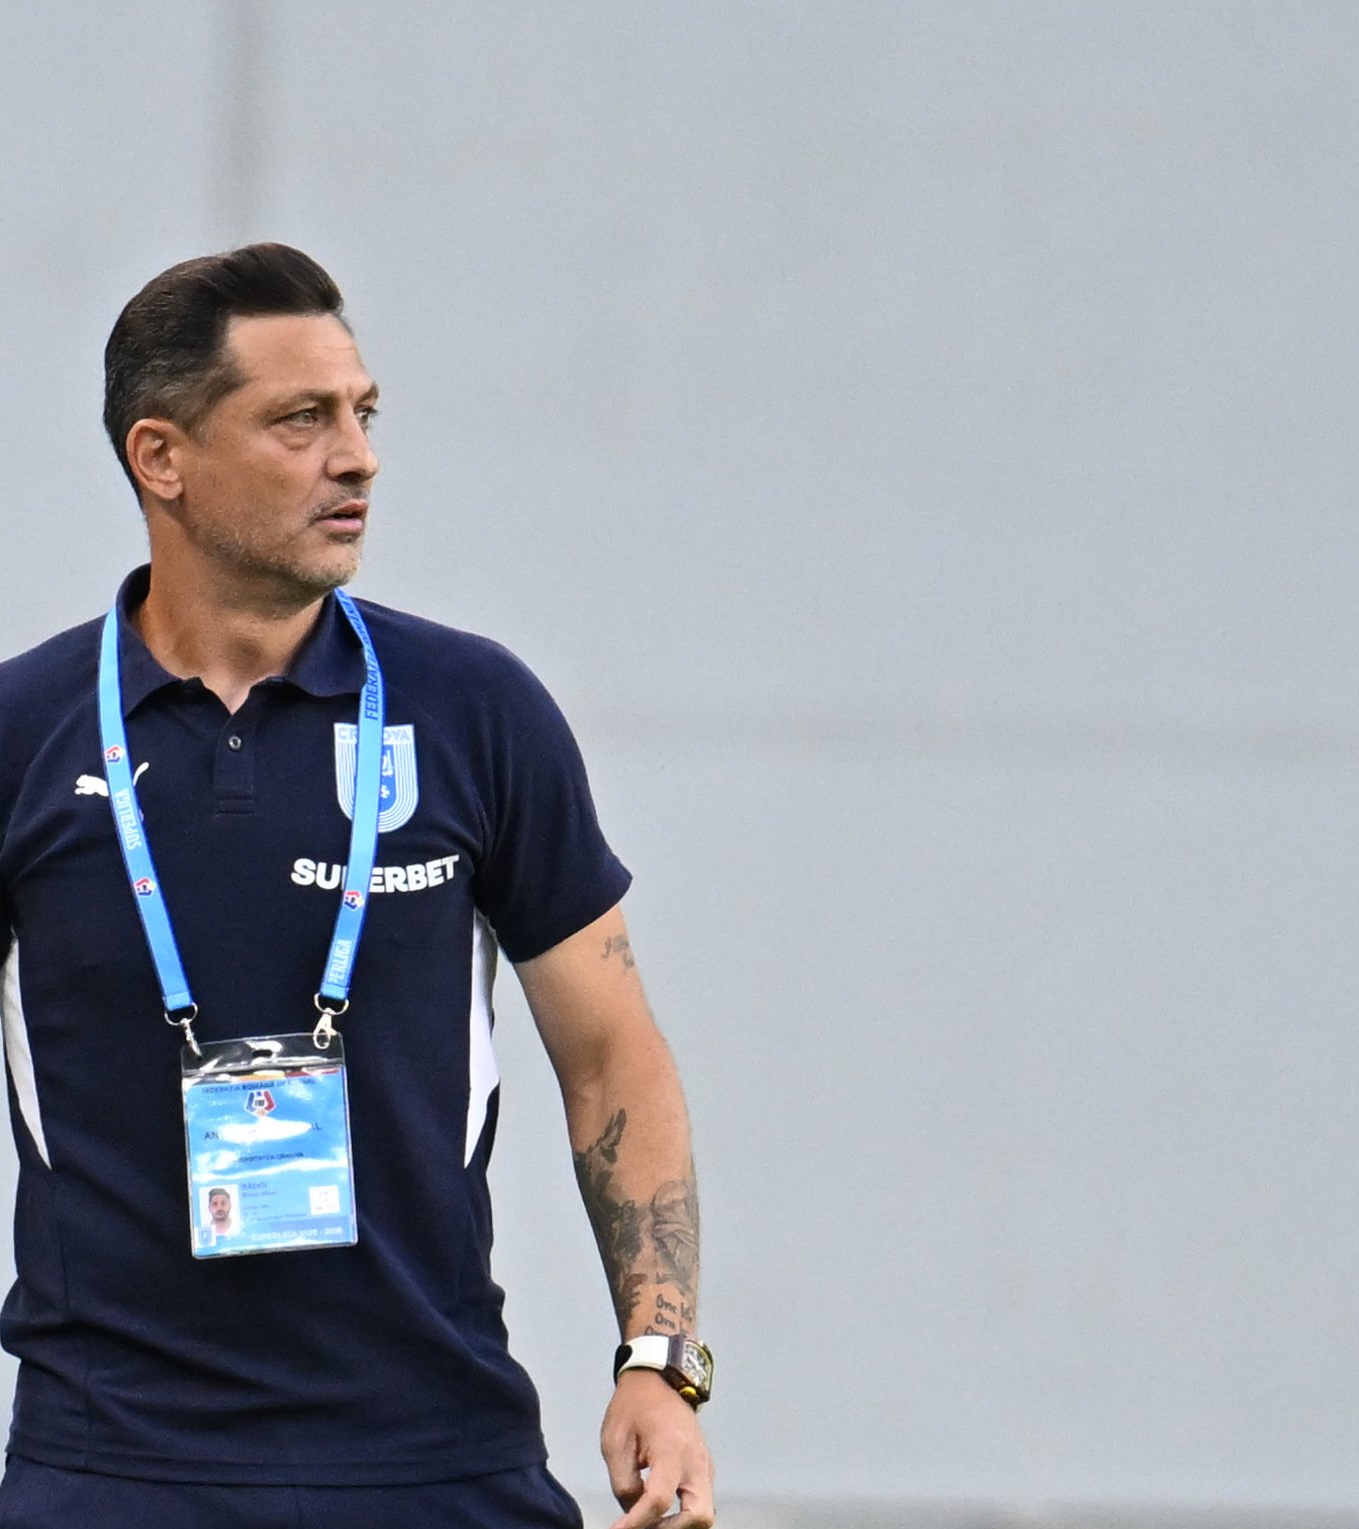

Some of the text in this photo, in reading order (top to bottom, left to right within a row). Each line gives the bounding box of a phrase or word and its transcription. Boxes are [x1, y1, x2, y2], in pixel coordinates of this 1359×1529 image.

[338, 726, 411, 740] CROVA
[114, 787, 142, 851] SUPERLIGA
[290, 854, 460, 894] SUERBET
